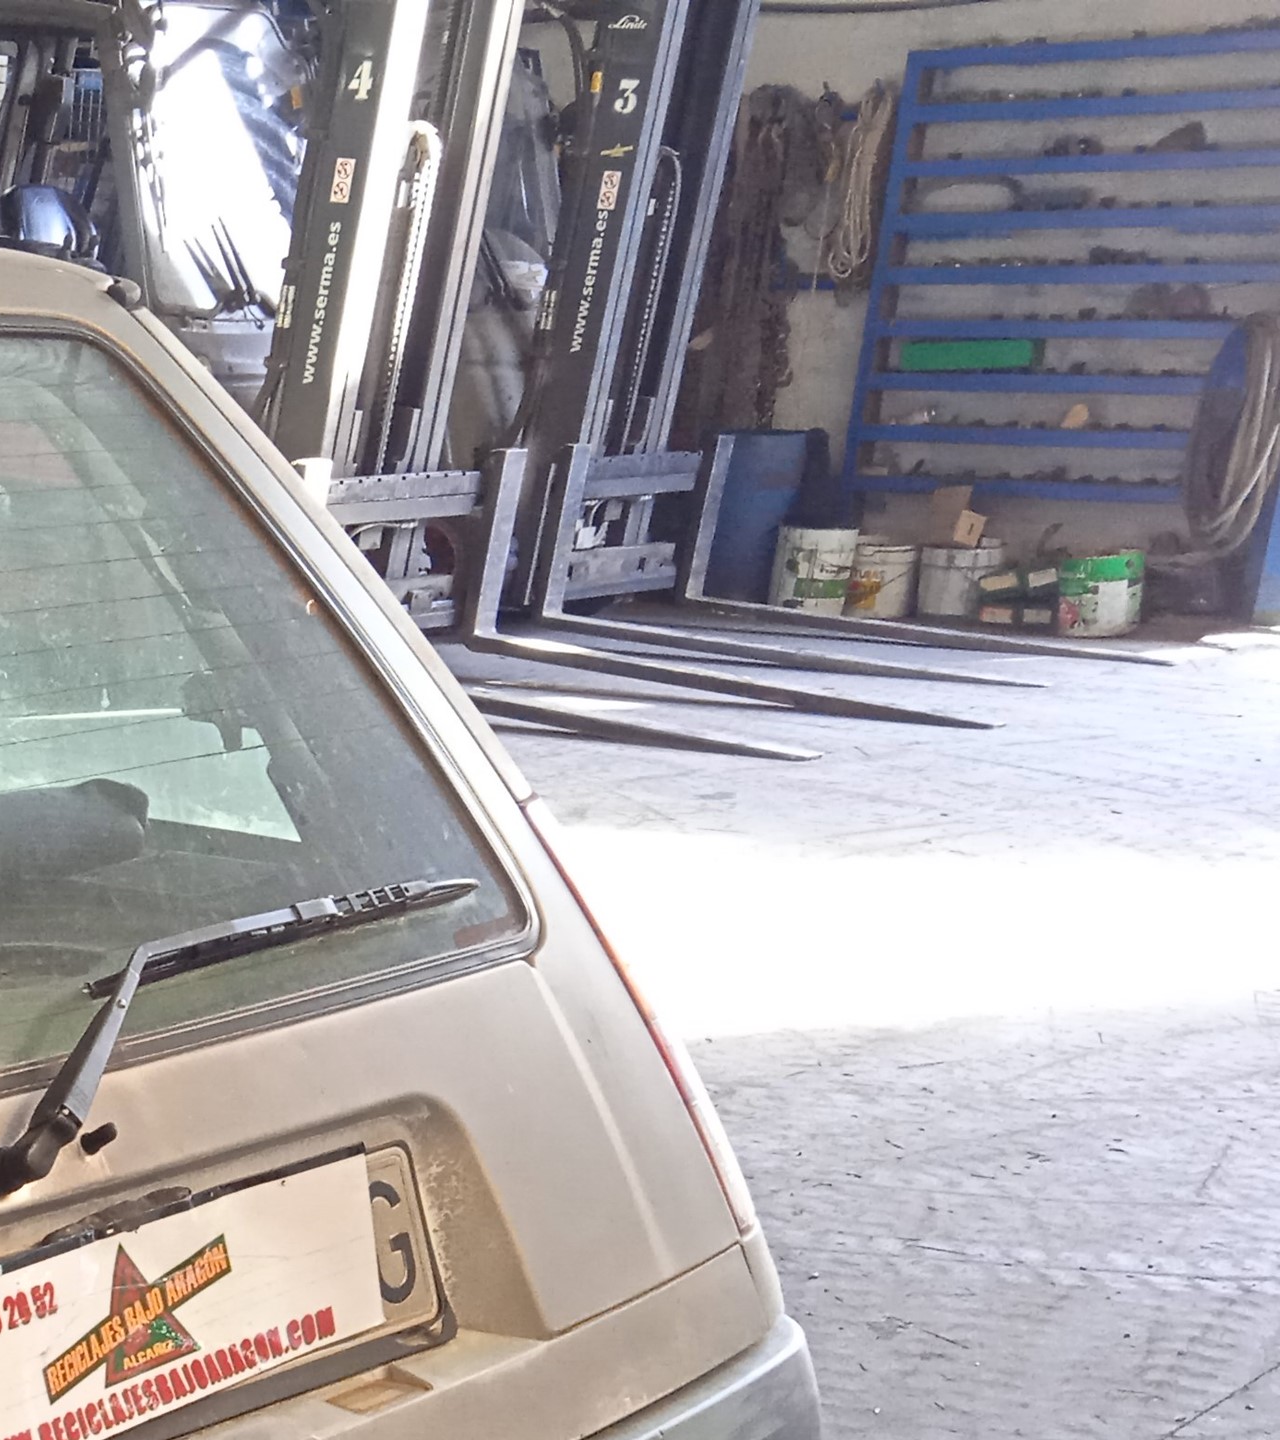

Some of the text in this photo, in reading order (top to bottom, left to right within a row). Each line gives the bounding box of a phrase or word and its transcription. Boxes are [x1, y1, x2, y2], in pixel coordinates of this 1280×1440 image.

[607, 14, 648, 30] Linde
[348, 60, 373, 100] 4
[613, 79, 640, 114] 3
[302, 221, 342, 384] www.serma.es
[570, 210, 609, 353] www.serma.es
[45, 1315, 127, 1394] RECICLAJES
[124, 1286, 165, 1332] BAJO
